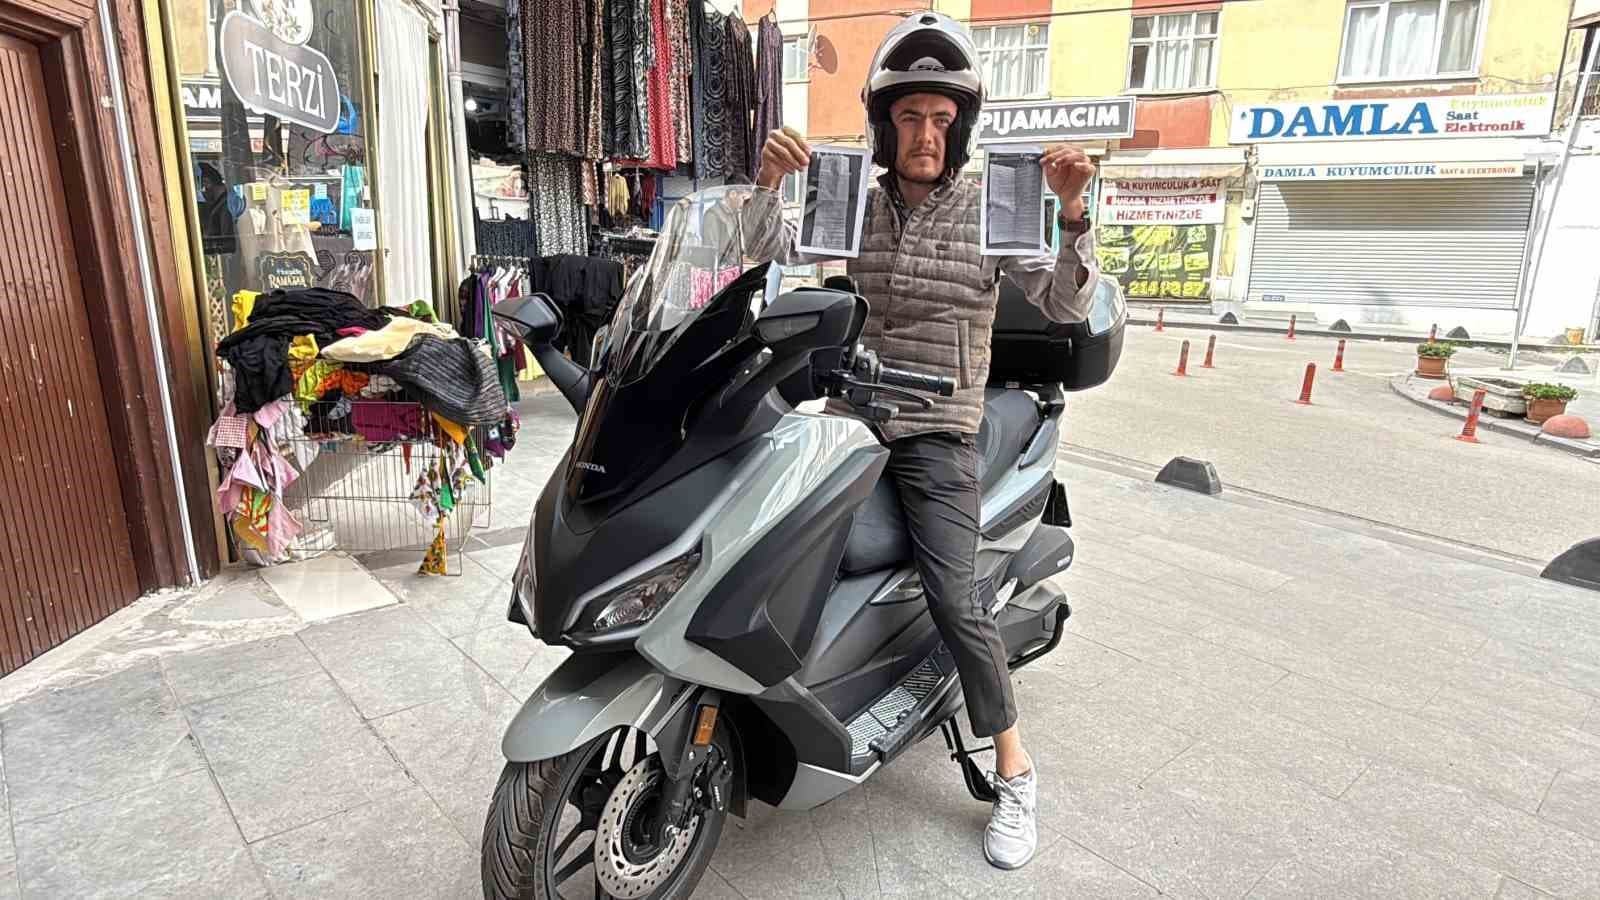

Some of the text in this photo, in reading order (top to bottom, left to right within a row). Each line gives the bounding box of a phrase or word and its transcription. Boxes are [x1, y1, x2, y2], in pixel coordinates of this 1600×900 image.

[1247, 102, 1438, 138] DAMLA
[1446, 111, 1479, 121] Saat
[1444, 120, 1525, 133] Elektronik
[1264, 167, 1316, 177] DAMLA
[1326, 165, 1436, 176] KUYUMCULUK
[1133, 181, 1190, 190] KUYUMCULUK
[1200, 178, 1221, 188] SAAT
